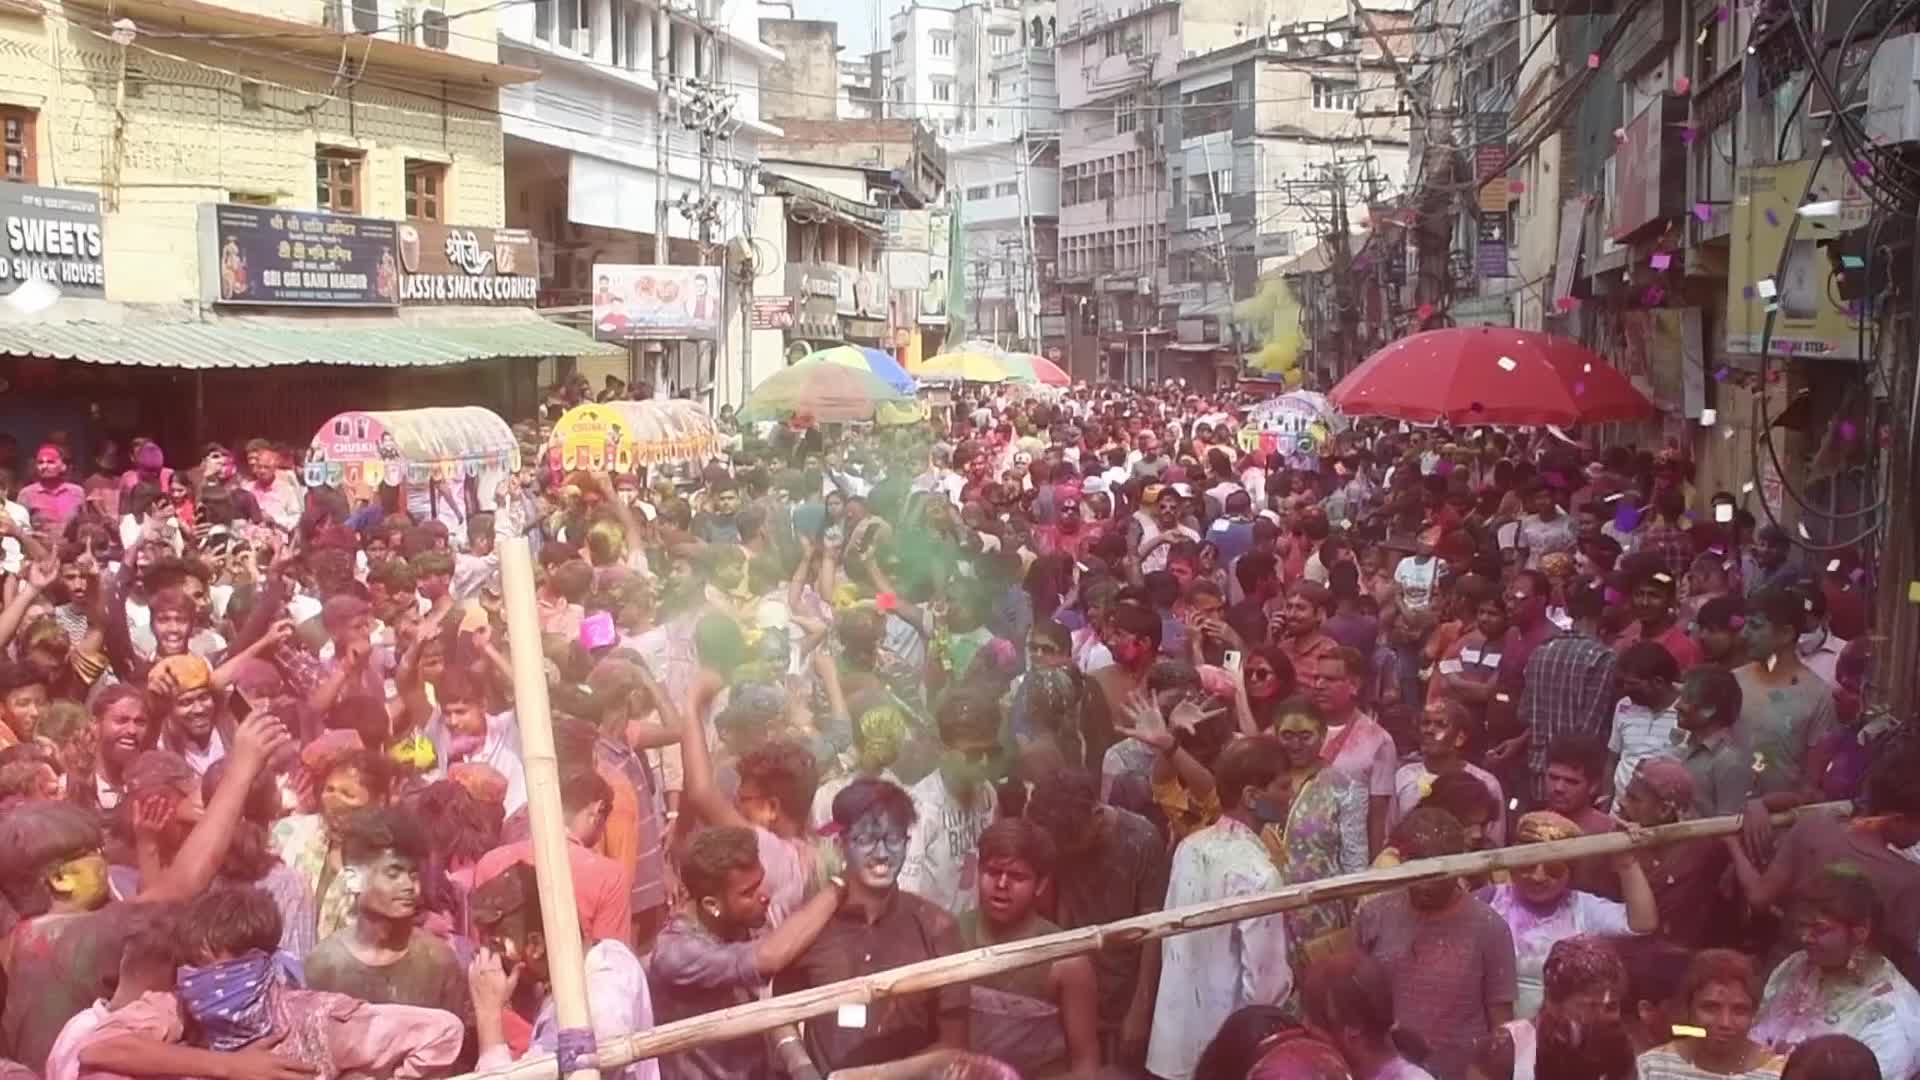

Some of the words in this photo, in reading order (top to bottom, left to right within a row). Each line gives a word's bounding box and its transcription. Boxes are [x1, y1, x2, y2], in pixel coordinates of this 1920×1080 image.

[7, 216, 102, 257] SWEETS
[14, 258, 58, 281] SNACK
[62, 261, 104, 285] HOUSE
[400, 274, 435, 299] LASSI
[447, 275, 493, 300] SNACKS
[495, 275, 537, 299] CORNER
